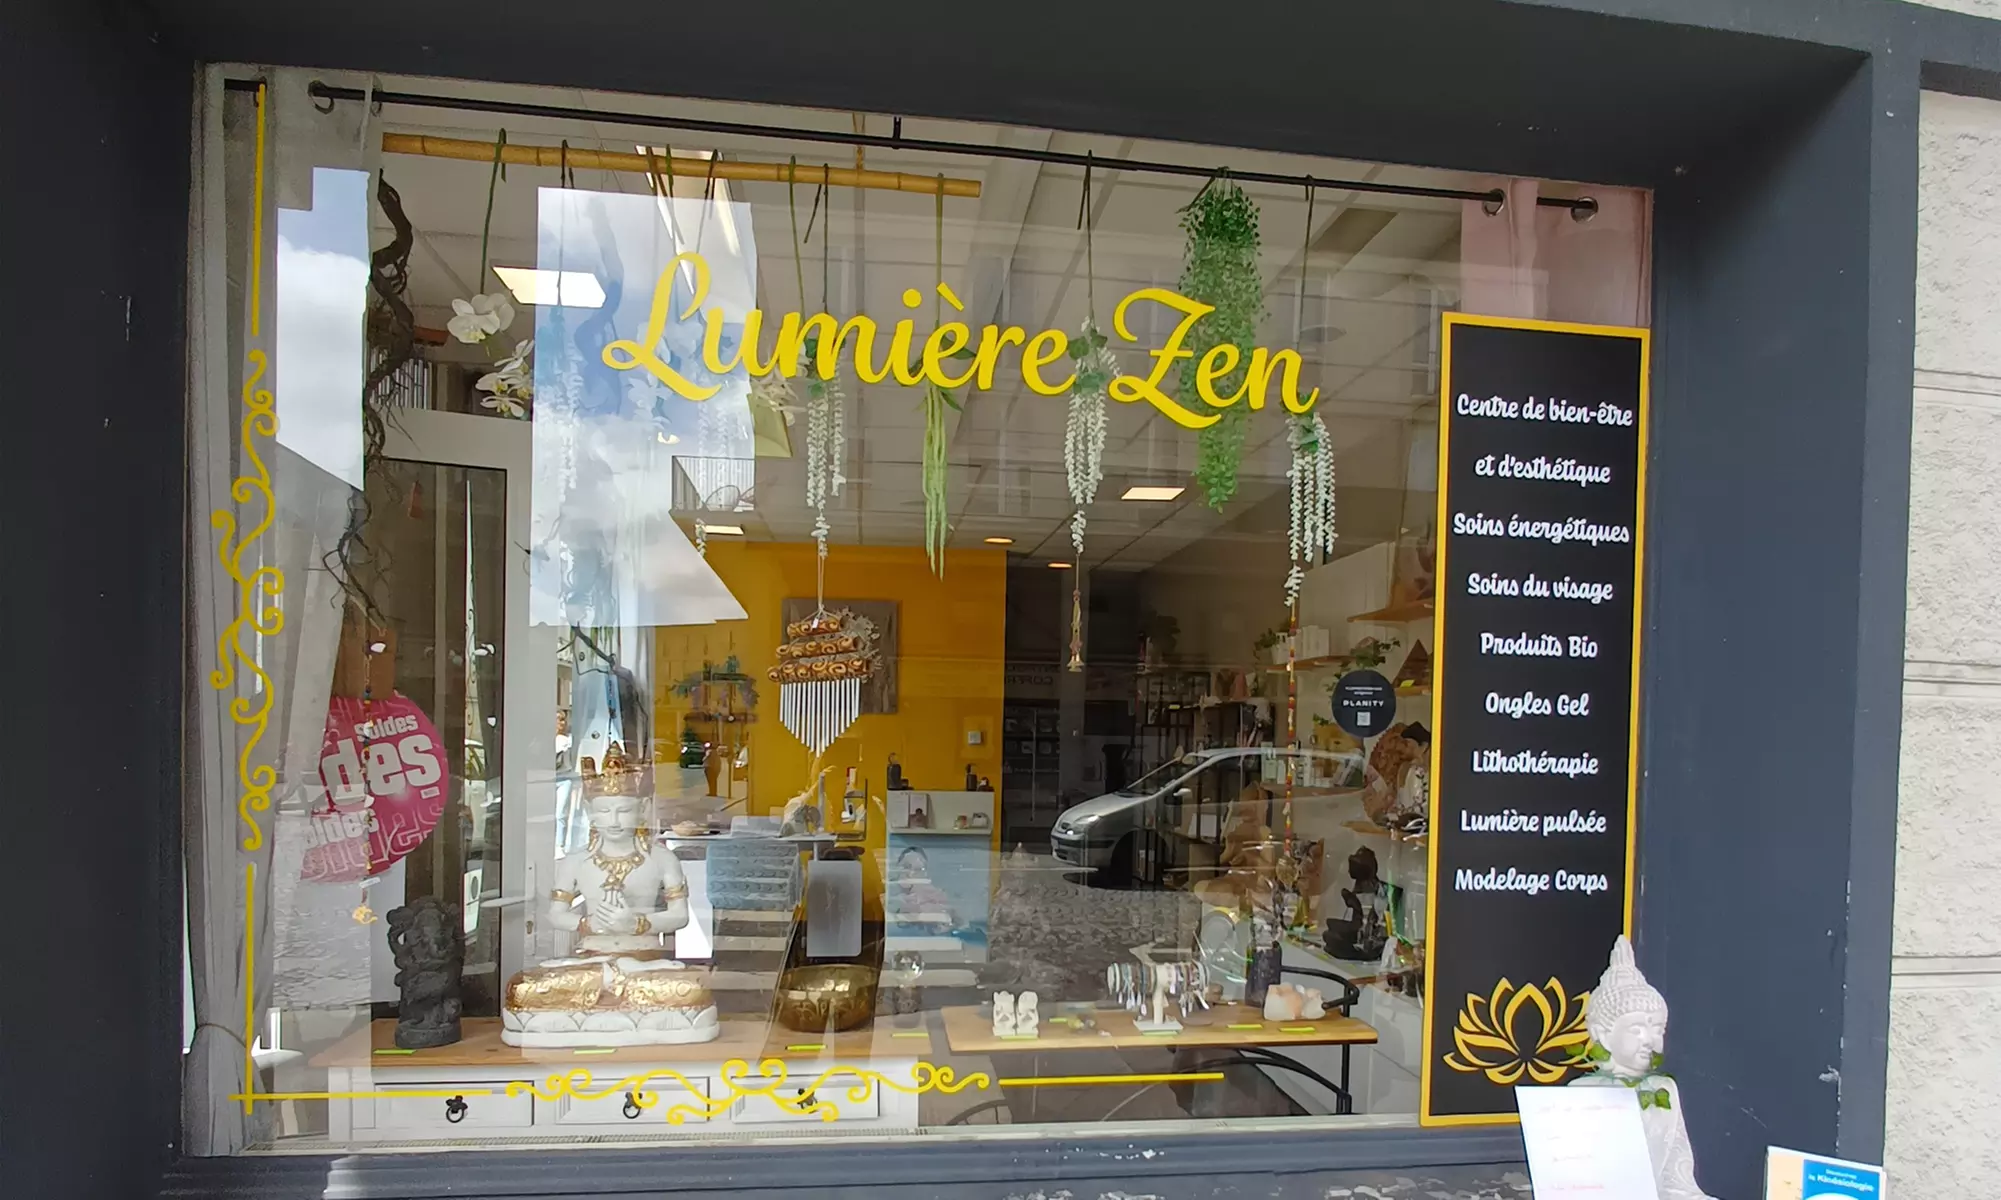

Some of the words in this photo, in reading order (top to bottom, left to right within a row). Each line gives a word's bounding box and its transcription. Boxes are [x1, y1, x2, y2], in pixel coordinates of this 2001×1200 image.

[601, 251, 1076, 401] Lumière
[1107, 288, 1320, 428] Zen
[1457, 393, 1519, 419] Centre
[1522, 396, 1546, 421] de
[1549, 398, 1633, 427] bien-être
[1475, 454, 1496, 477] et
[1498, 454, 1611, 488] d'esthétique
[1453, 512, 1505, 537] Soins
[1507, 514, 1630, 547] énergétiques
[1467, 572, 1520, 597] Soins
[1522, 574, 1551, 598] du
[1552, 575, 1613, 605] visage
[1480, 632, 1563, 657] Produits
[1567, 635, 1599, 658] Bio
[1342, 699, 1384, 708] PLANITY
[1485, 691, 1552, 719] Ongles
[1556, 692, 1590, 716] Gel
[1472, 748, 1599, 779] Lithothérapie
[1461, 808, 1540, 832] Lumière
[1542, 809, 1607, 837] pulsée
[1454, 866, 1550, 896] Modelage
[1555, 869, 1608, 895] Corps
